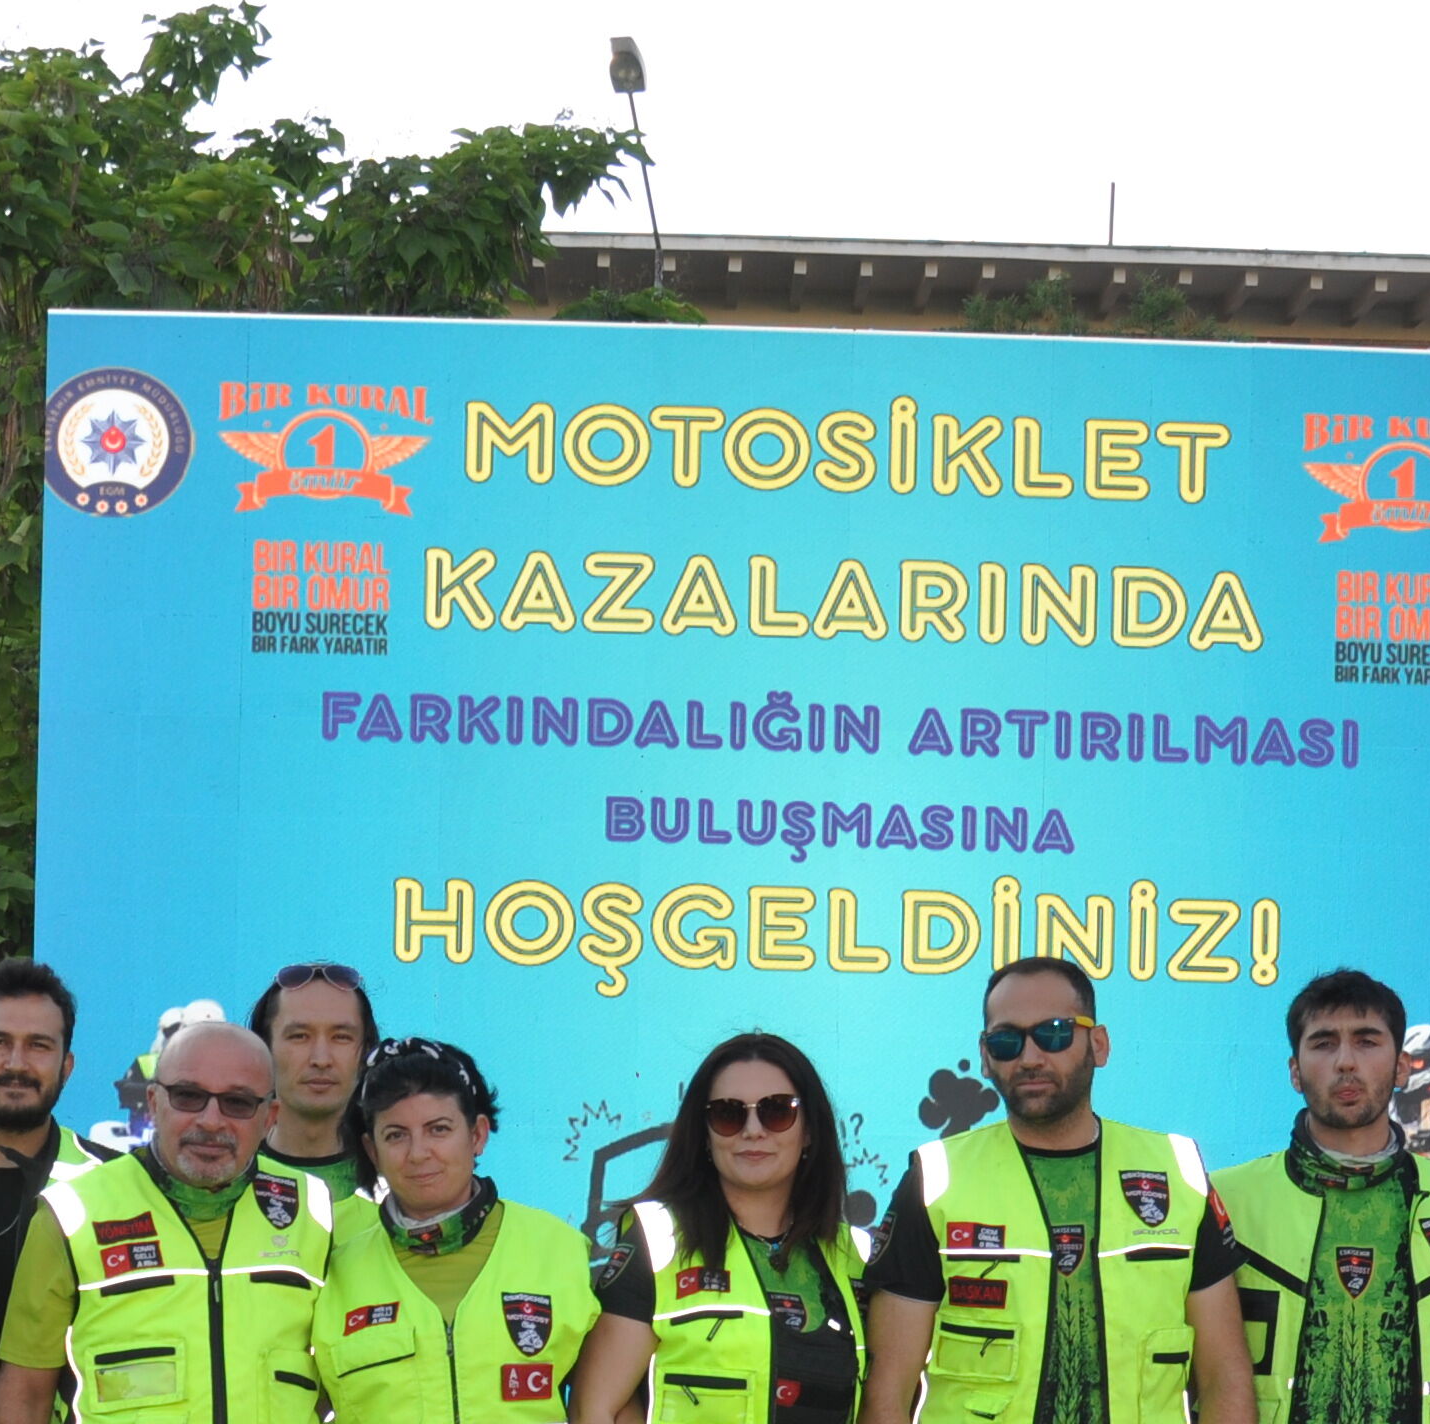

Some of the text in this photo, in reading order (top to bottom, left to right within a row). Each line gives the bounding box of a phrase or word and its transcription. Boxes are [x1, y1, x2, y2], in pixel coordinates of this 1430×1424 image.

[306, 383, 434, 426] KURAL
[464, 395, 1231, 504] MOTOSİKLET
[304, 540, 391, 576] KURAL
[424, 546, 1265, 653] KAZALARINDA
[251, 611, 301, 634] BOYU
[279, 636, 320, 654] FARK
[1335, 640, 1382, 665] BOYU
[1362, 665, 1401, 685] FARK
[321, 690, 1361, 769] FARKINDALIĞIN ARTIRILMASI
[605, 796, 1076, 863] BULUŞMASINA
[392, 875, 1282, 997] HOŞGELDİNİZ!
